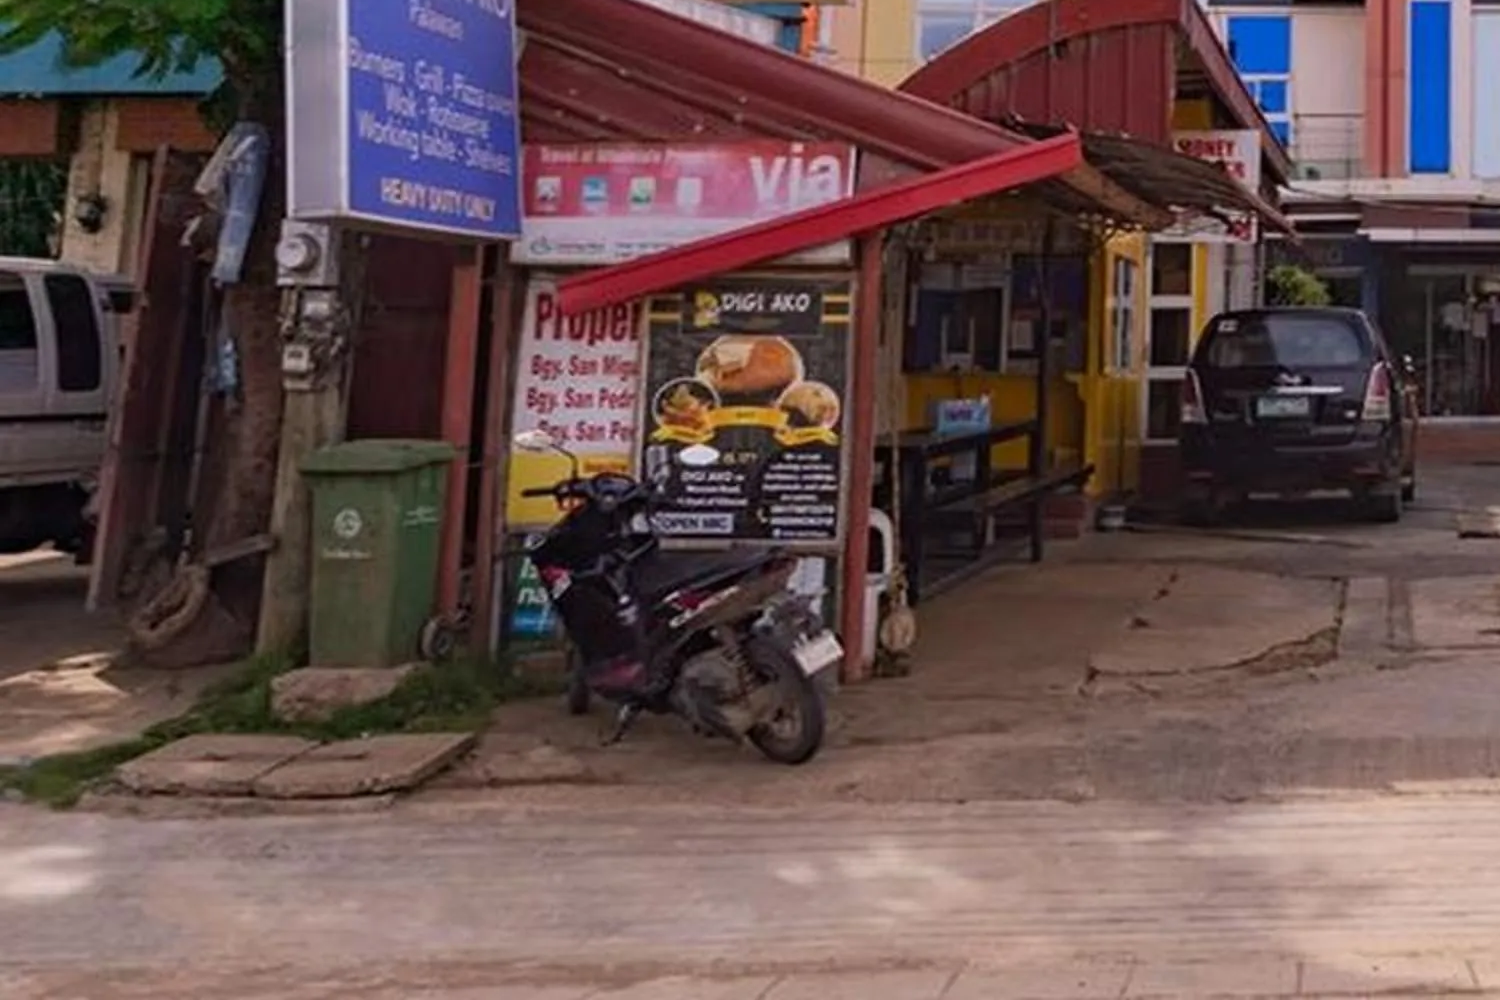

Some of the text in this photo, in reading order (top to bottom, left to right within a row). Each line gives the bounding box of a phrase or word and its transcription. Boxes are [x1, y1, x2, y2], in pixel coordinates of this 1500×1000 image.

[356, 111, 420, 161] Working
[750, 142, 842, 206] via
[428, 183, 463, 216] DUTY
[464, 194, 498, 222] ONLY
[720, 291, 811, 313] DIGI AKO
[568, 354, 598, 376] San
[564, 386, 594, 409] San
[575, 420, 606, 442] San
